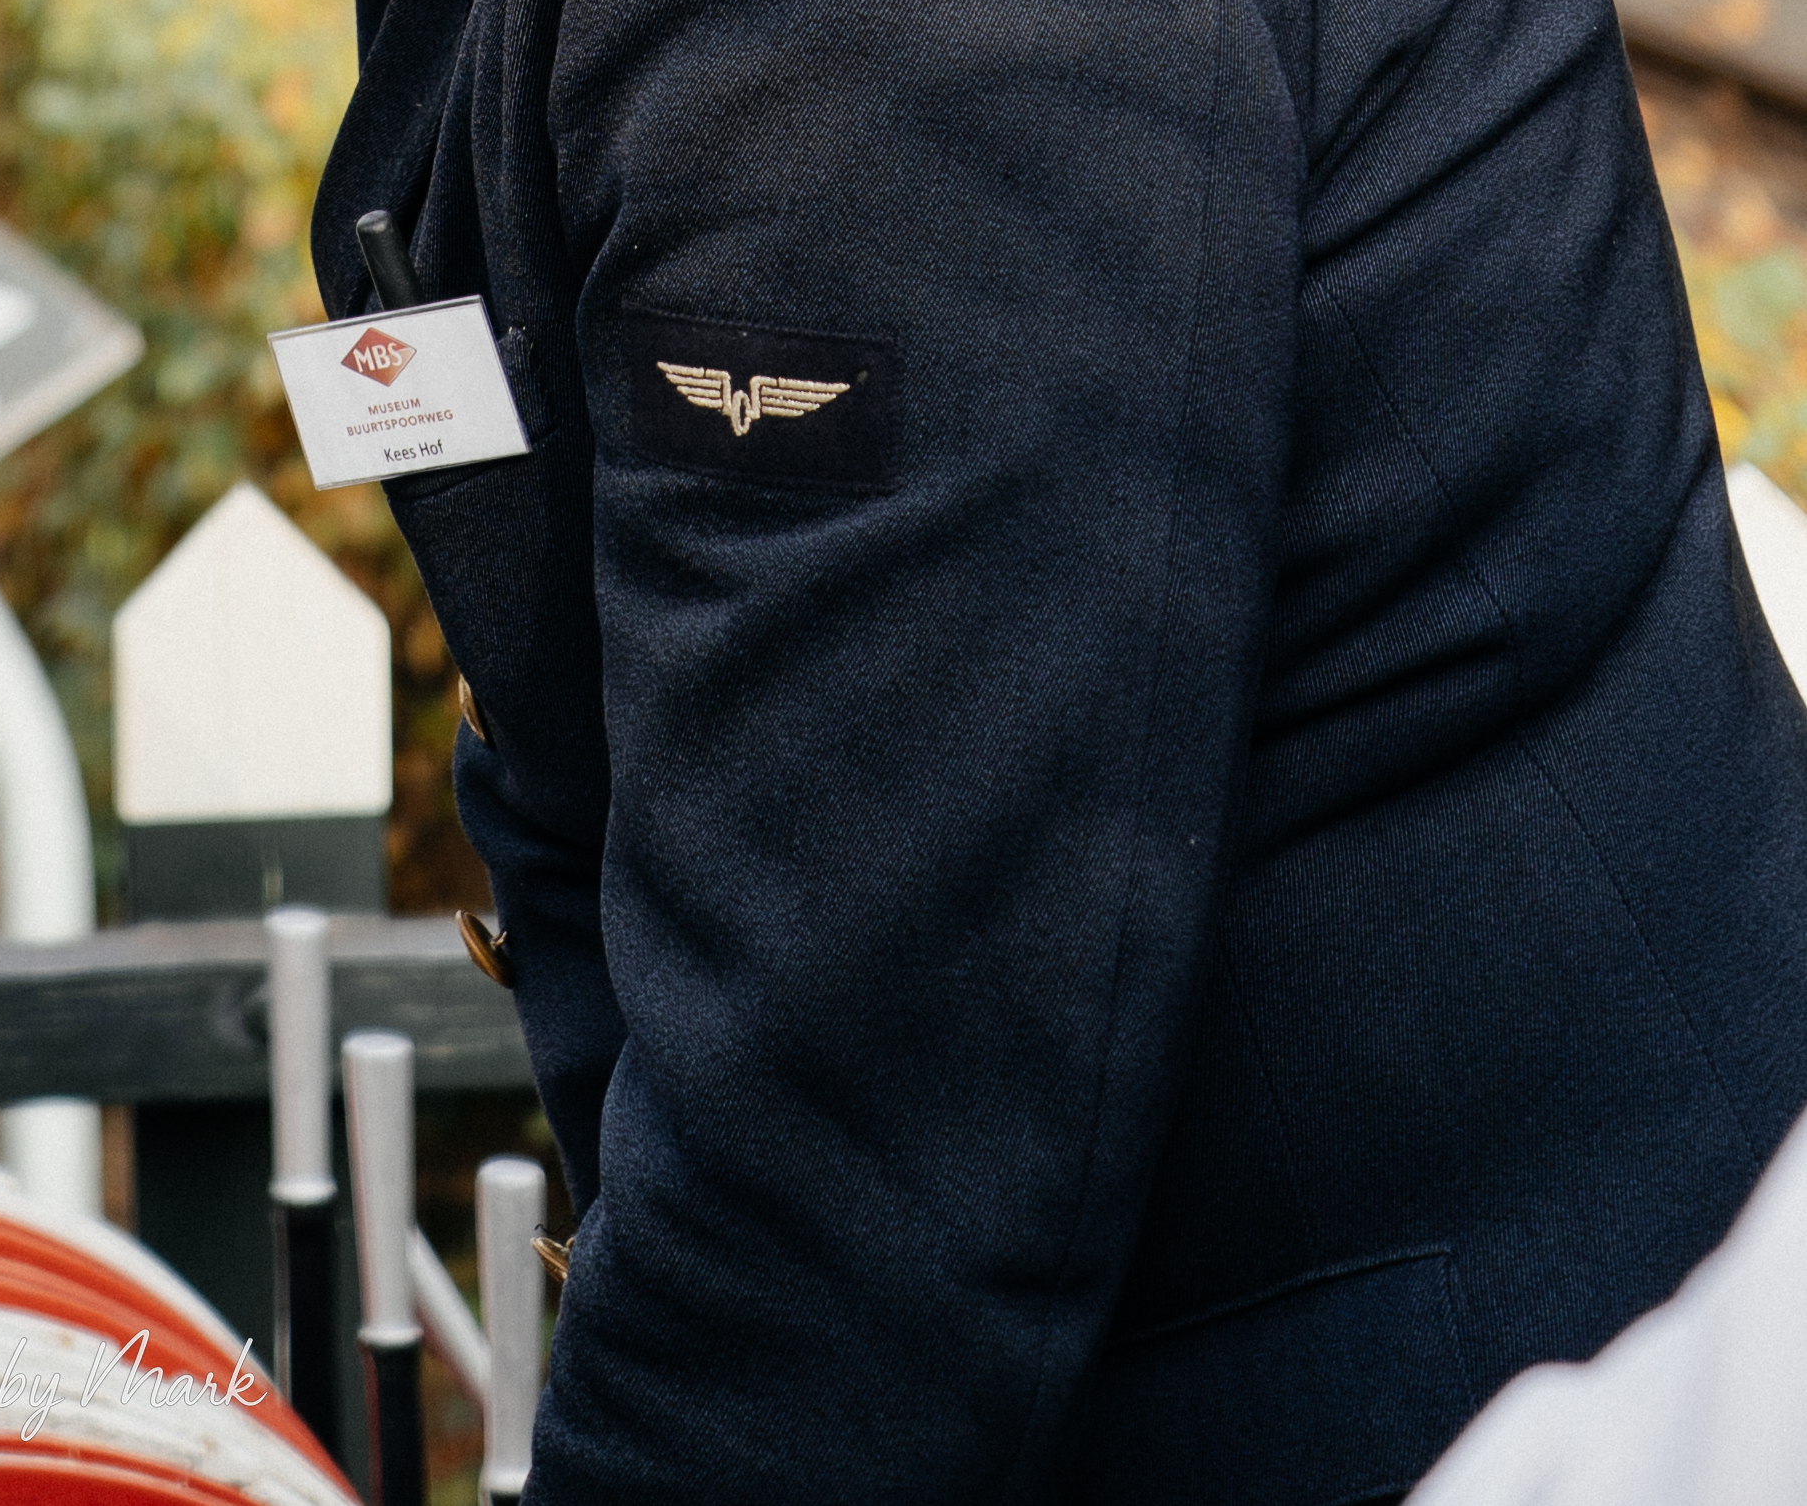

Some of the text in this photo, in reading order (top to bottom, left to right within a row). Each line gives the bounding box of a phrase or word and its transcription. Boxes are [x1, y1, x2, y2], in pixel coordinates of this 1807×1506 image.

[352, 342, 403, 373] MBS
[367, 398, 421, 415] MUSEUM
[346, 409, 454, 436] BUURTSPOORWEG
[383, 439, 443, 462] Kees Hof
